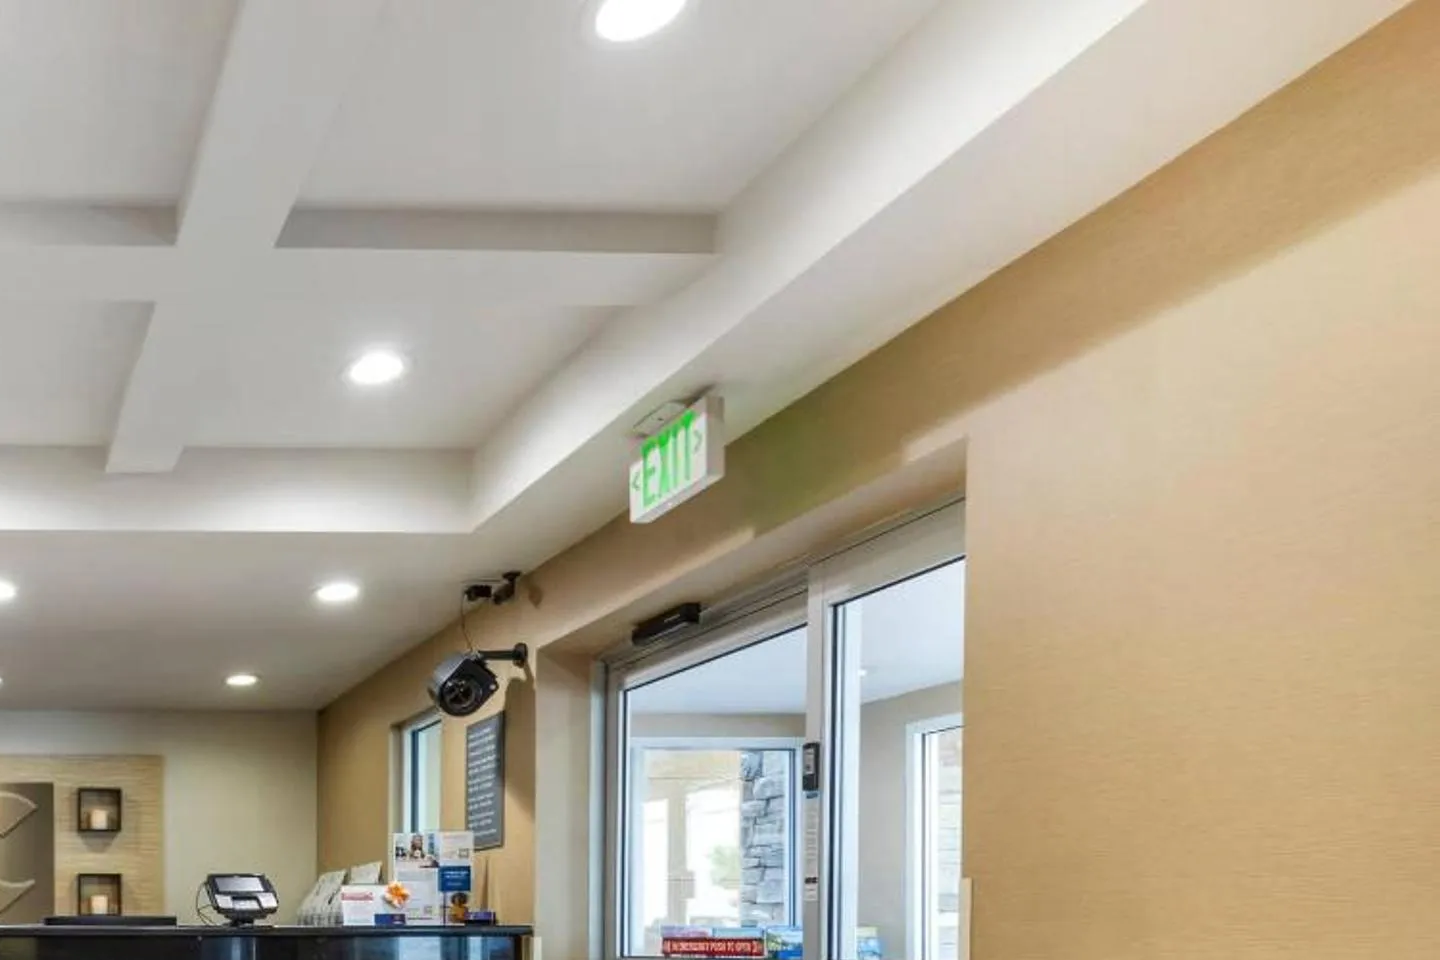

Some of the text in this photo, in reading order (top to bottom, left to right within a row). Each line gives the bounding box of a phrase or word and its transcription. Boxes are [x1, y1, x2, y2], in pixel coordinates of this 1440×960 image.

[642, 409, 696, 507] EXIT
[679, 941, 710, 953] EMERGENCY
[711, 941, 727, 953] PUSH
[727, 941, 735, 953] TO
[735, 941, 752, 953] OPEN
